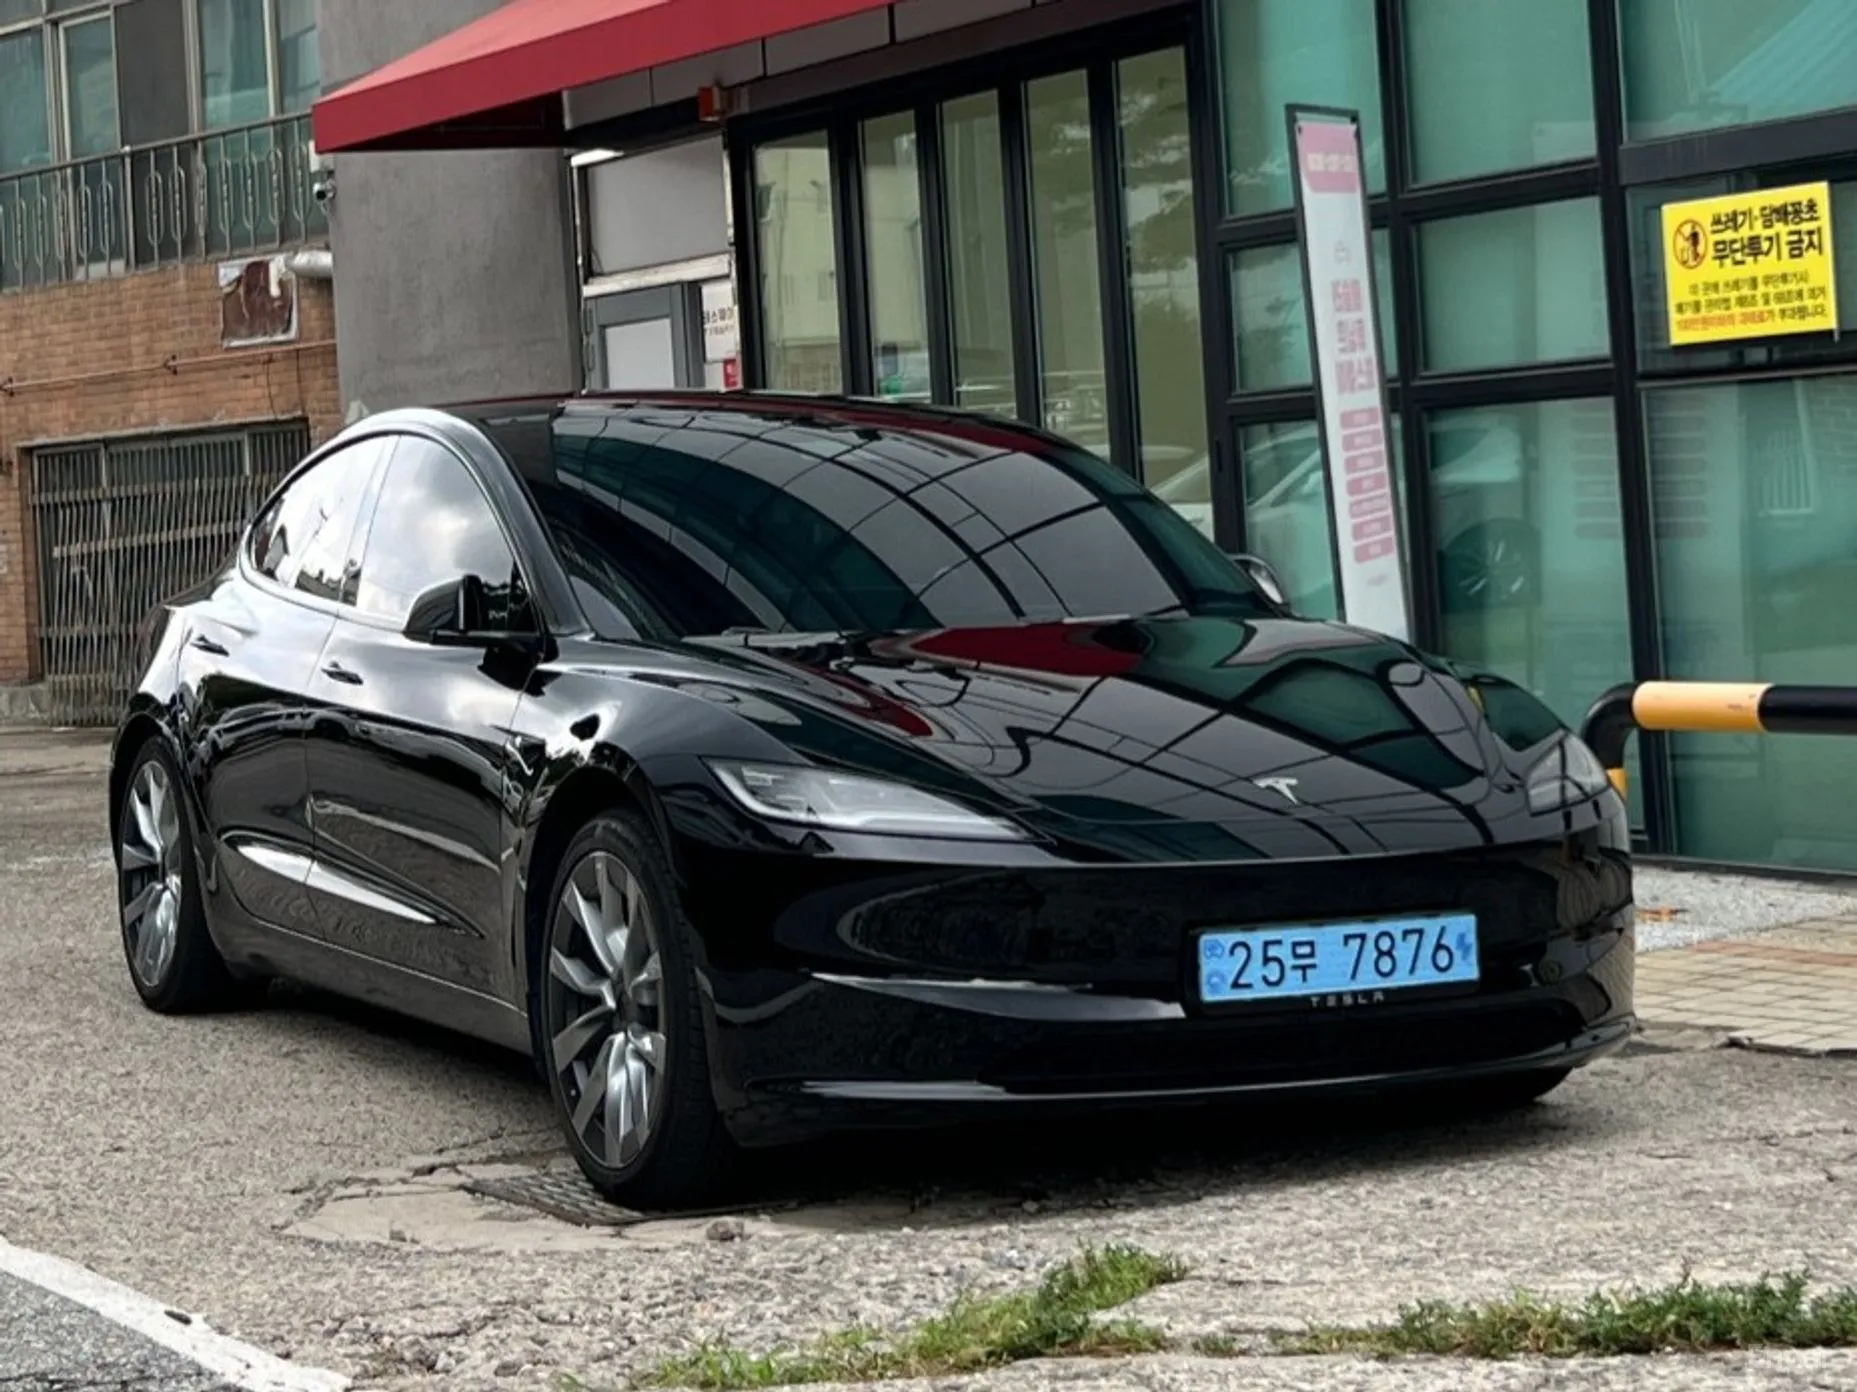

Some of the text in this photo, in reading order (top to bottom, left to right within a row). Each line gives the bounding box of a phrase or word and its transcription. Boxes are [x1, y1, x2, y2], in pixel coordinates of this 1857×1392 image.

[1712, 226, 1823, 268] 무단투기 금지
[1228, 926, 1456, 990] 25무 7876
[1310, 991, 1386, 1008] TESLA
